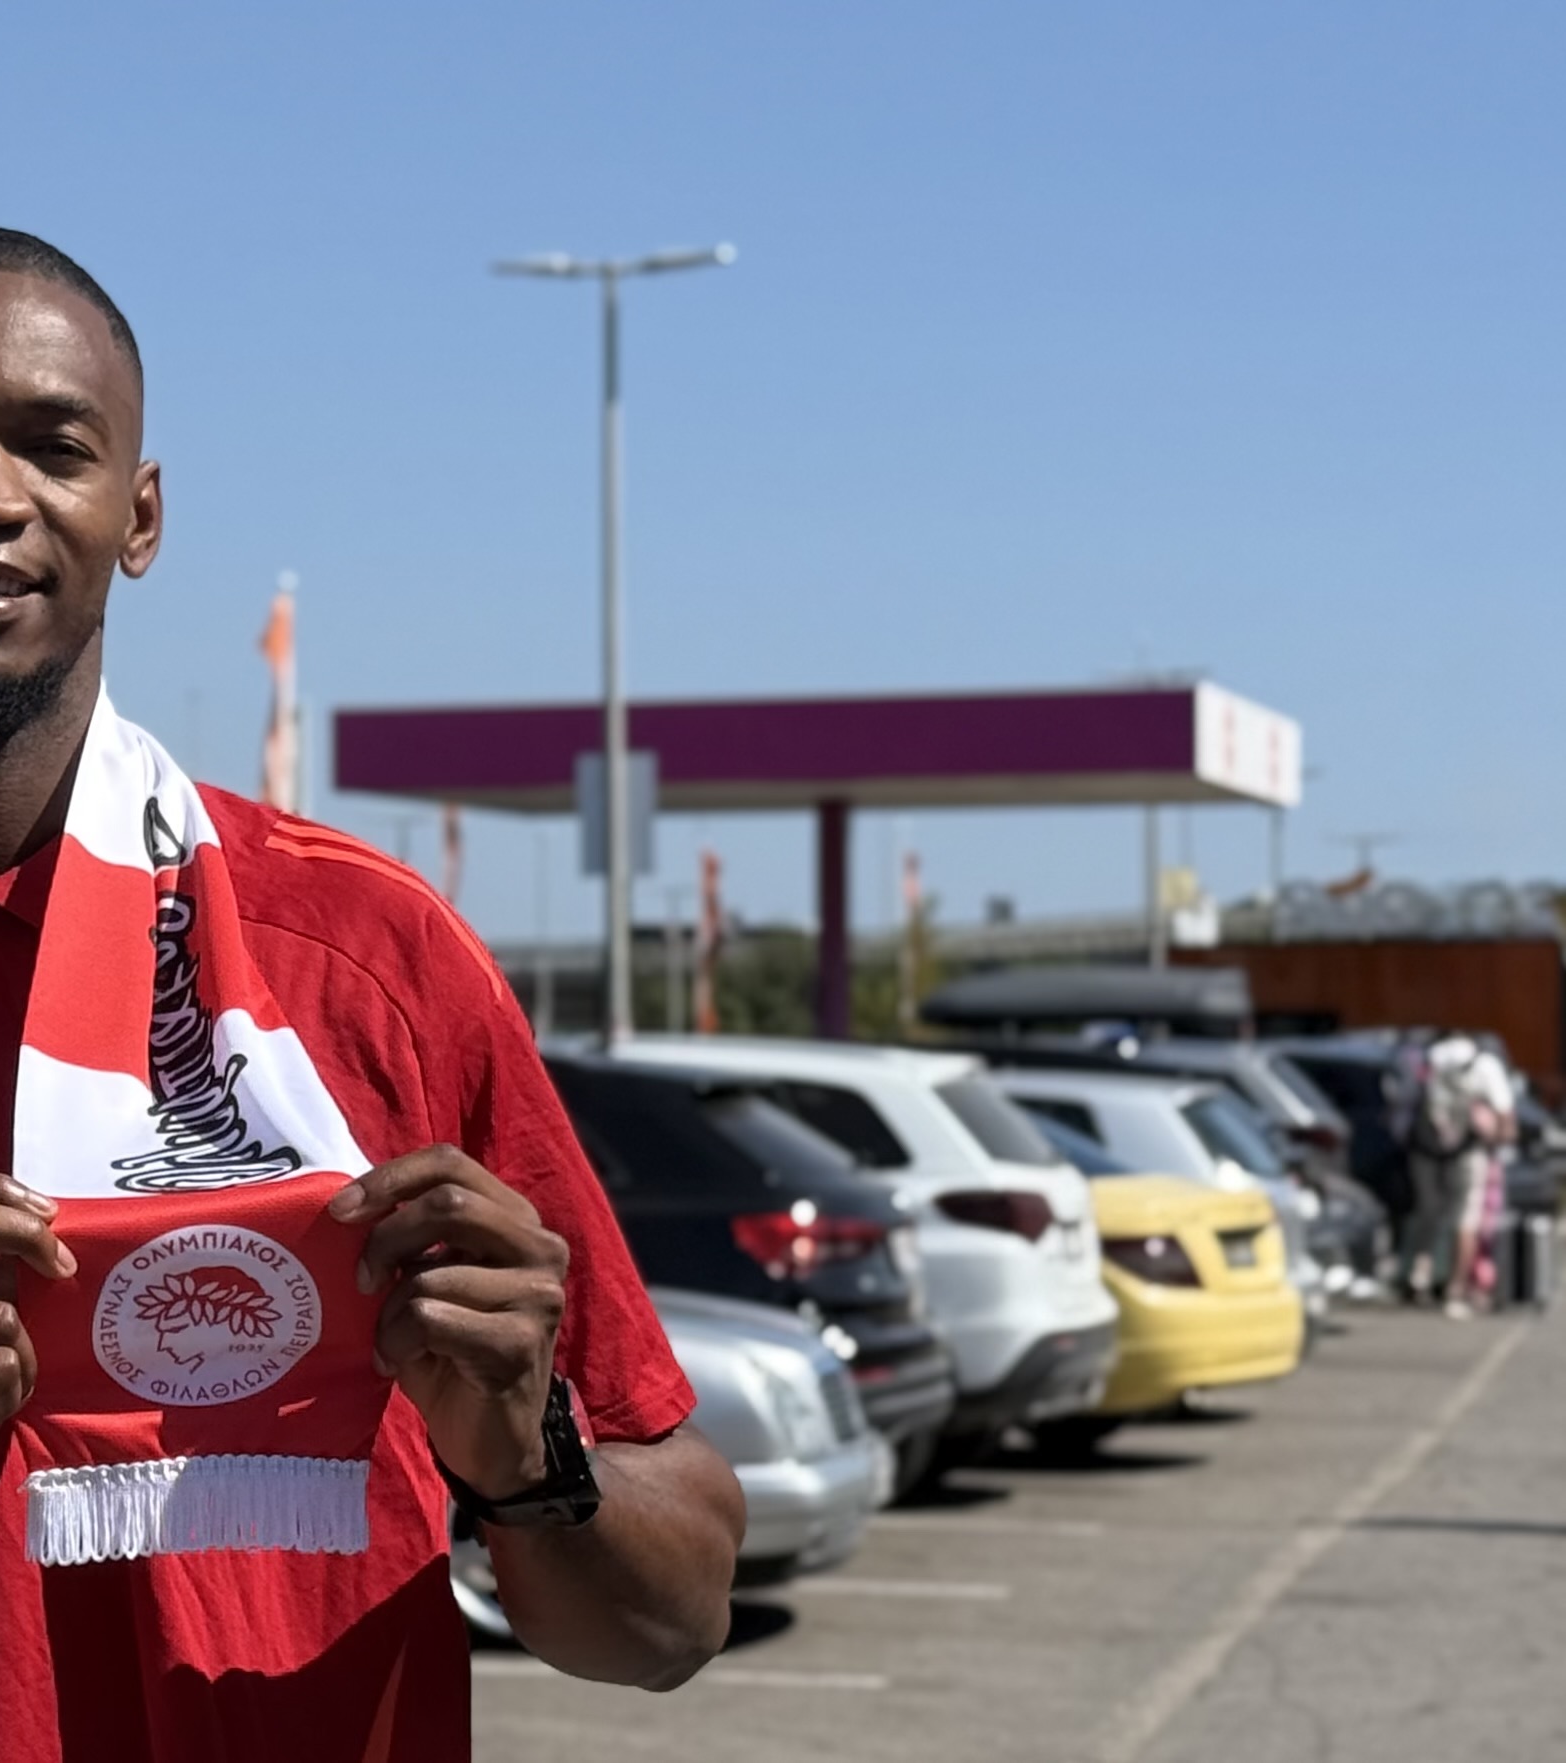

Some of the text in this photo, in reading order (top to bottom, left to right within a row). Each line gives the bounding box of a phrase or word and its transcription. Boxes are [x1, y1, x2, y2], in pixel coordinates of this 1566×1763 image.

[132, 1232, 289, 1273] ΟΛΥΜΠΙΑΚΟΣ
[99, 1273, 314, 1401] ΣΥΝΔΕΣΜΟΣ ΦΙΛΑΘΛΩΝ ΠΕΙΡΑΙΩΣ
[227, 1342, 267, 1354] 1925
